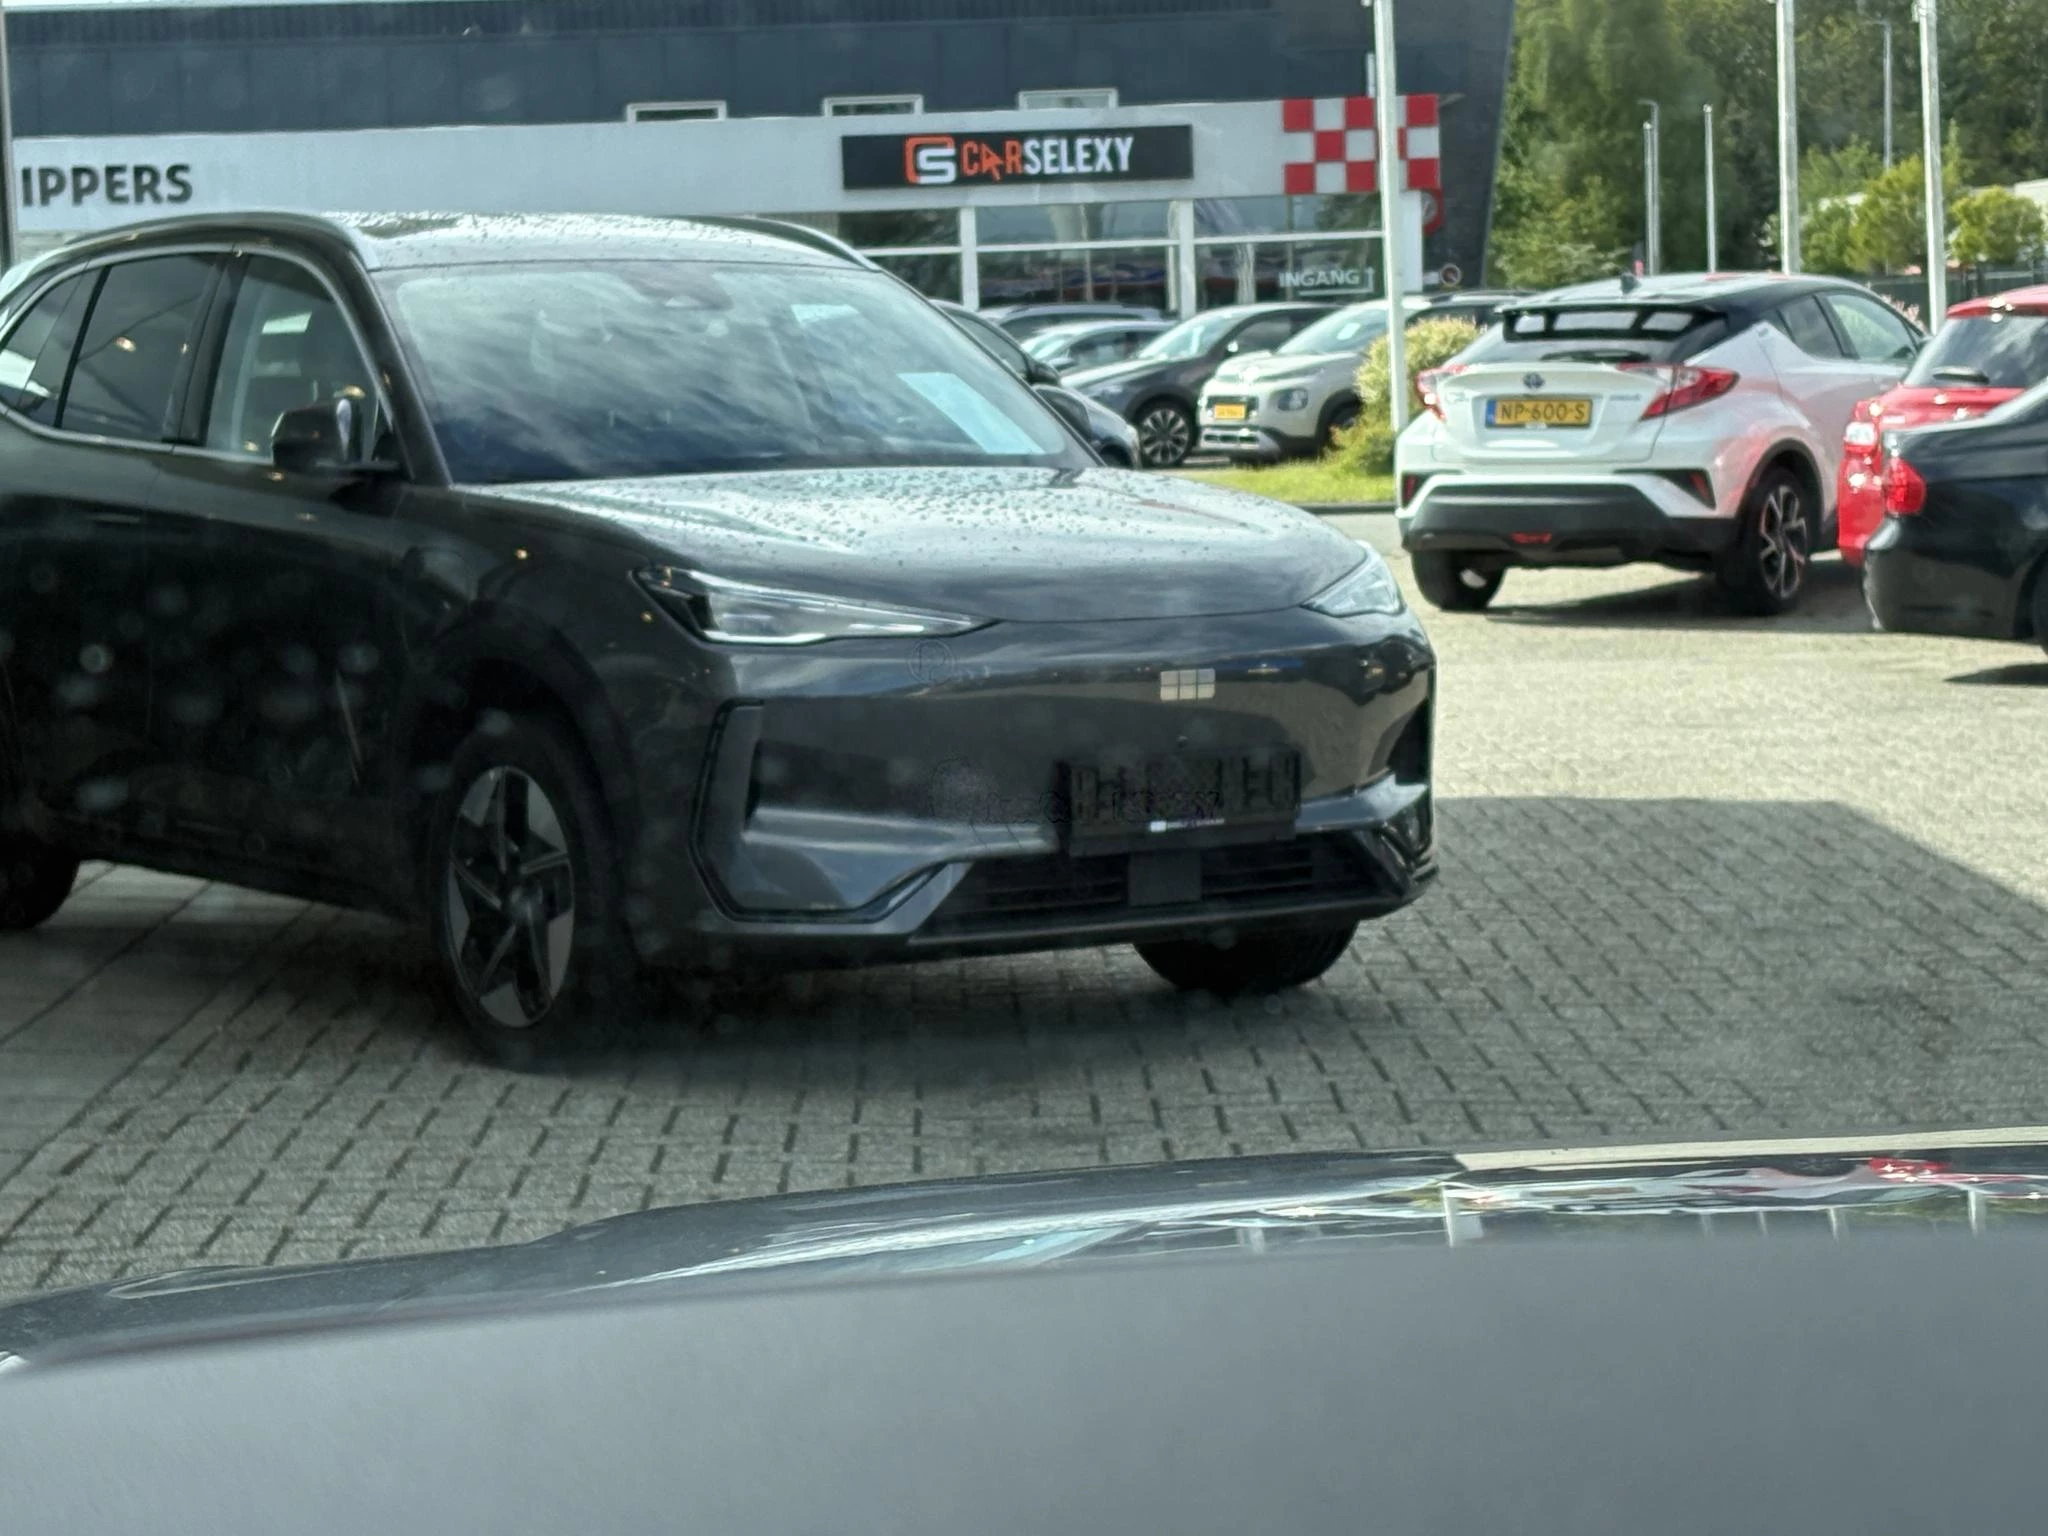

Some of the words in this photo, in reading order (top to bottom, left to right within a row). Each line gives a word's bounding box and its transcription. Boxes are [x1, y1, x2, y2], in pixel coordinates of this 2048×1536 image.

[21, 163, 193, 207] IPPERS
[1278, 269, 1360, 288] INGANG
[1500, 403, 1585, 422] NP-600-S
